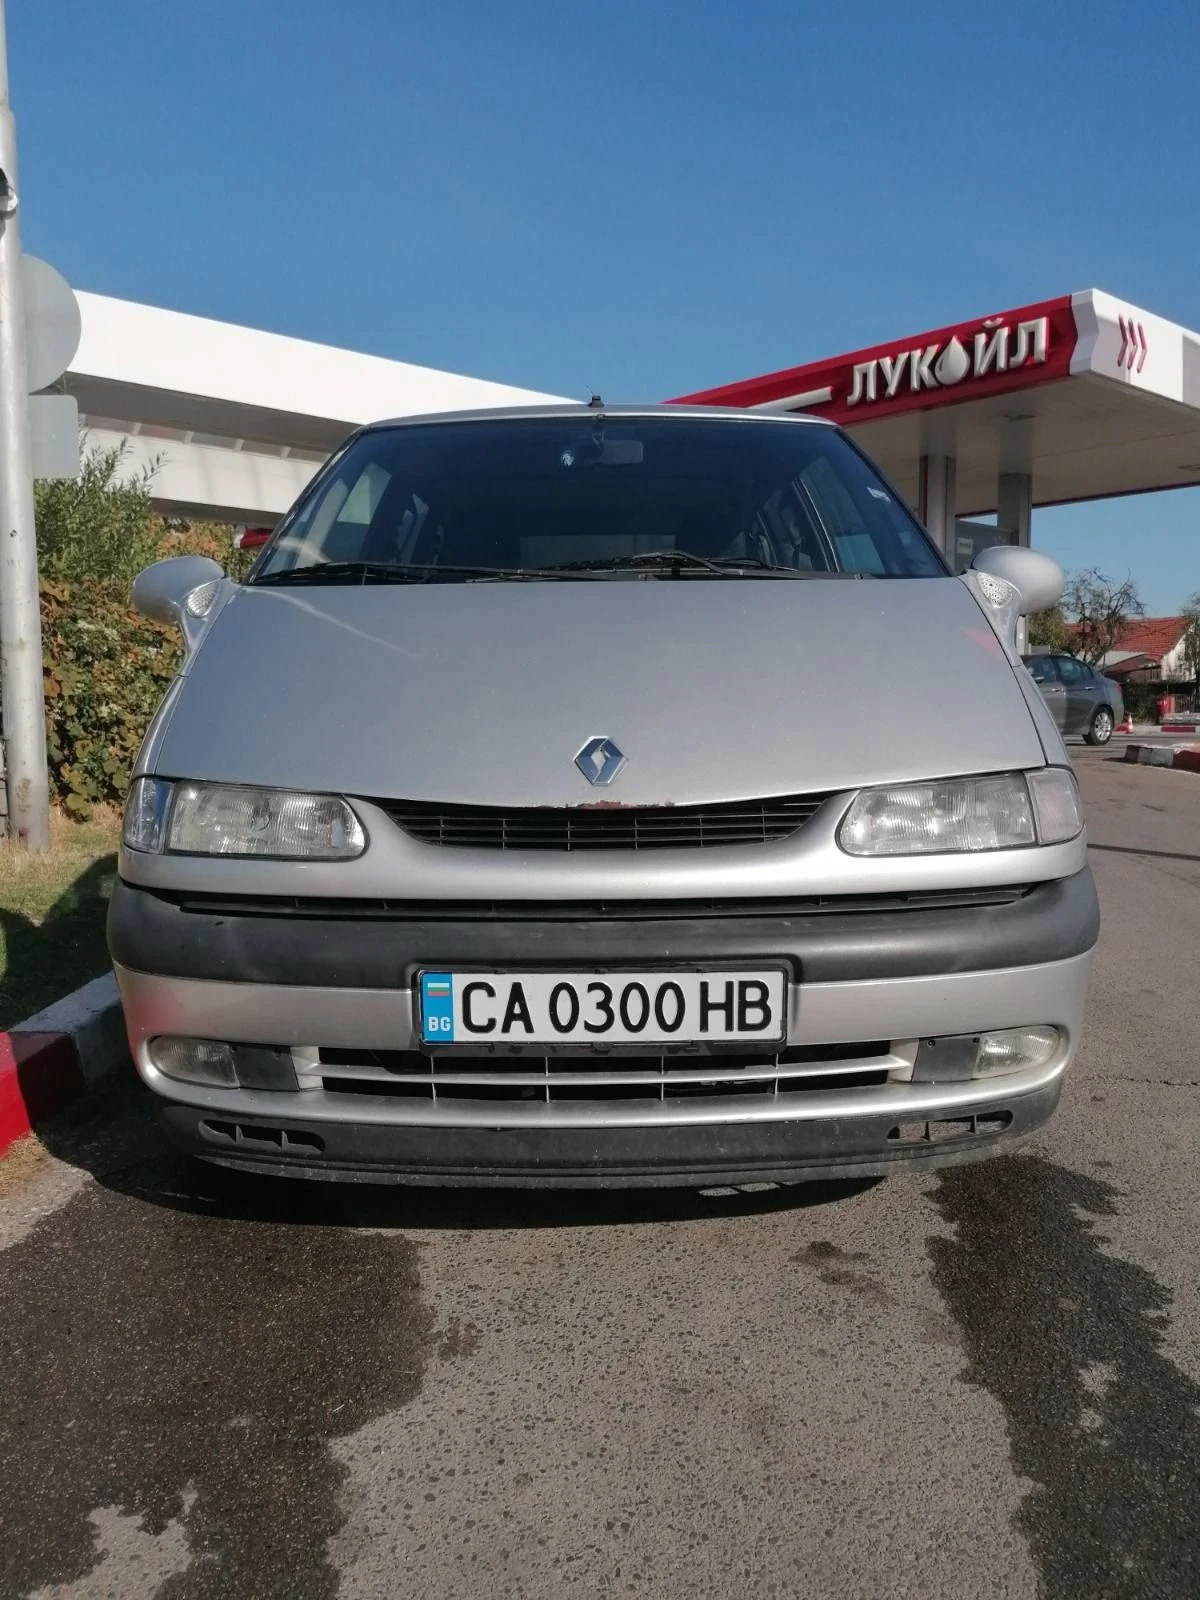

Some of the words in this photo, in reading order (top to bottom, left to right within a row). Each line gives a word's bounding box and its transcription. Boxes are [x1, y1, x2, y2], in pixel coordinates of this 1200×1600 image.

[427, 1016, 452, 1032] BG
[461, 981, 535, 1034] CA
[548, 981, 686, 1034] 0300
[699, 979, 772, 1032] HB
